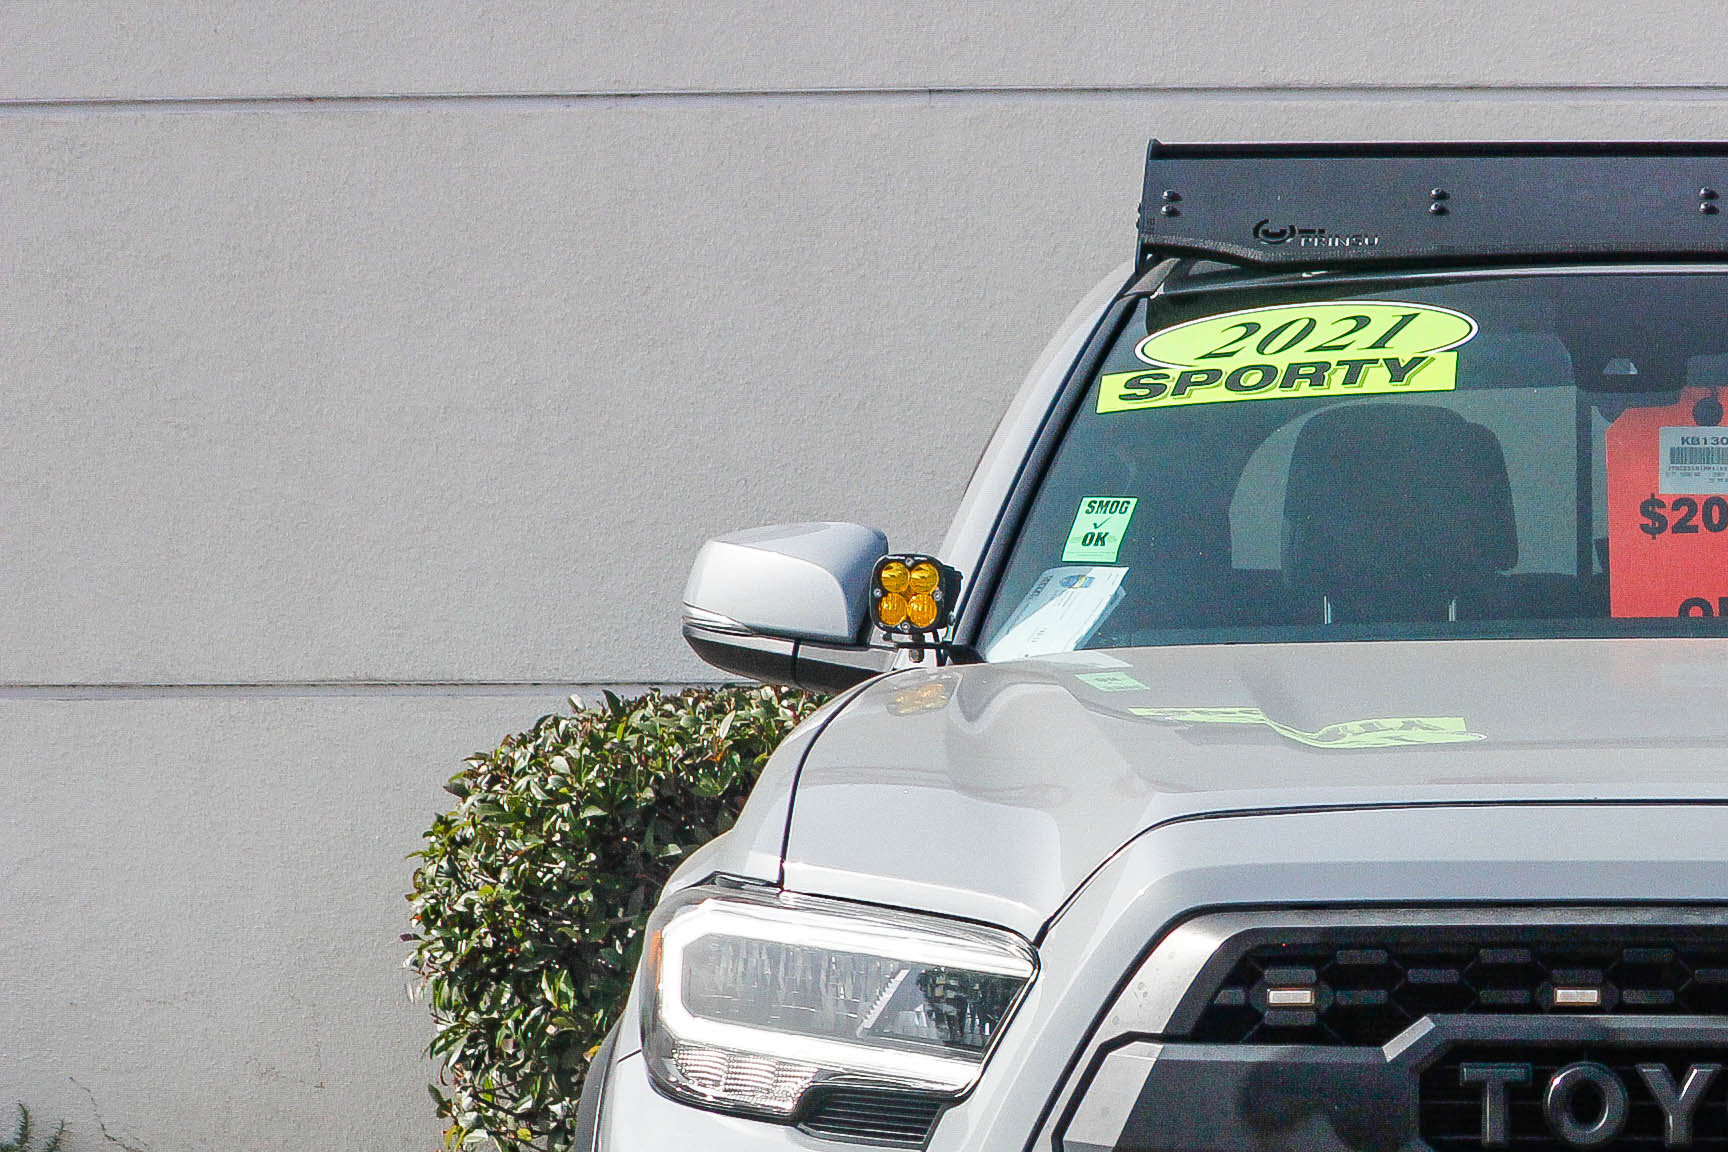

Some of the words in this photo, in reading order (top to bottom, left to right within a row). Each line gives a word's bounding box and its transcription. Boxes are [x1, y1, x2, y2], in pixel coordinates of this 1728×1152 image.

[1195, 312, 1422, 361] 2021
[1118, 356, 1433, 403] SPORTY
[1084, 500, 1131, 515] SMOG
[1081, 532, 1110, 547] OK
